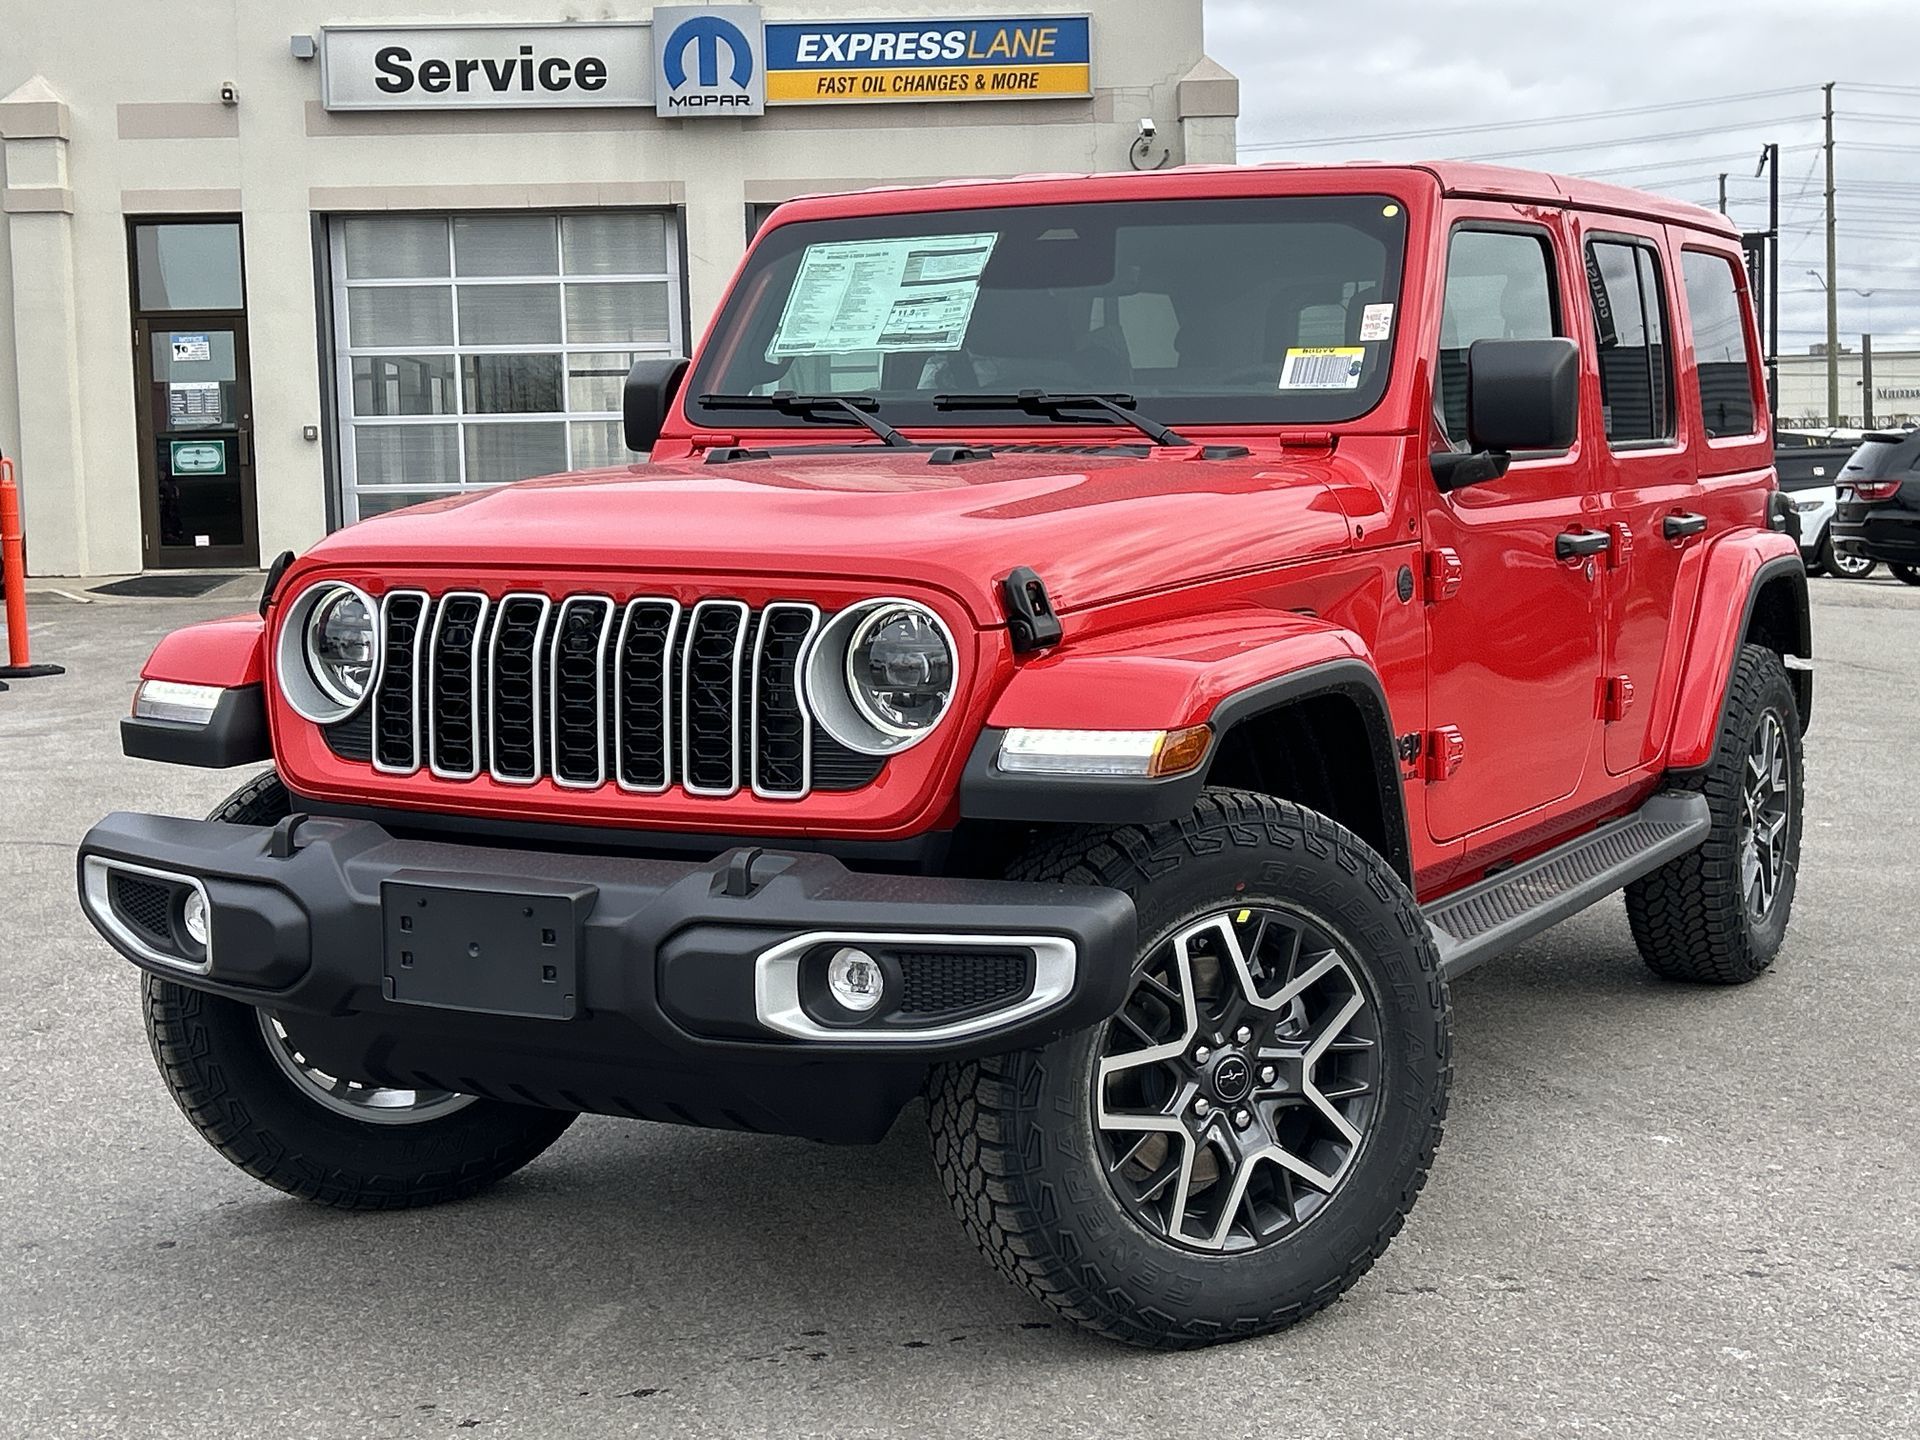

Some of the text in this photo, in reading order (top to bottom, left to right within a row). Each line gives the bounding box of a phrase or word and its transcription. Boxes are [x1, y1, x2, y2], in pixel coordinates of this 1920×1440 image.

[374, 45, 607, 93] Service
[816, 71, 1039, 94] FAST OIL CHANGES & MORE
[668, 95, 751, 108] MOPAR
[1254, 859, 1421, 1014] GRABBER
[1054, 1079, 1204, 1308] GENERAL
